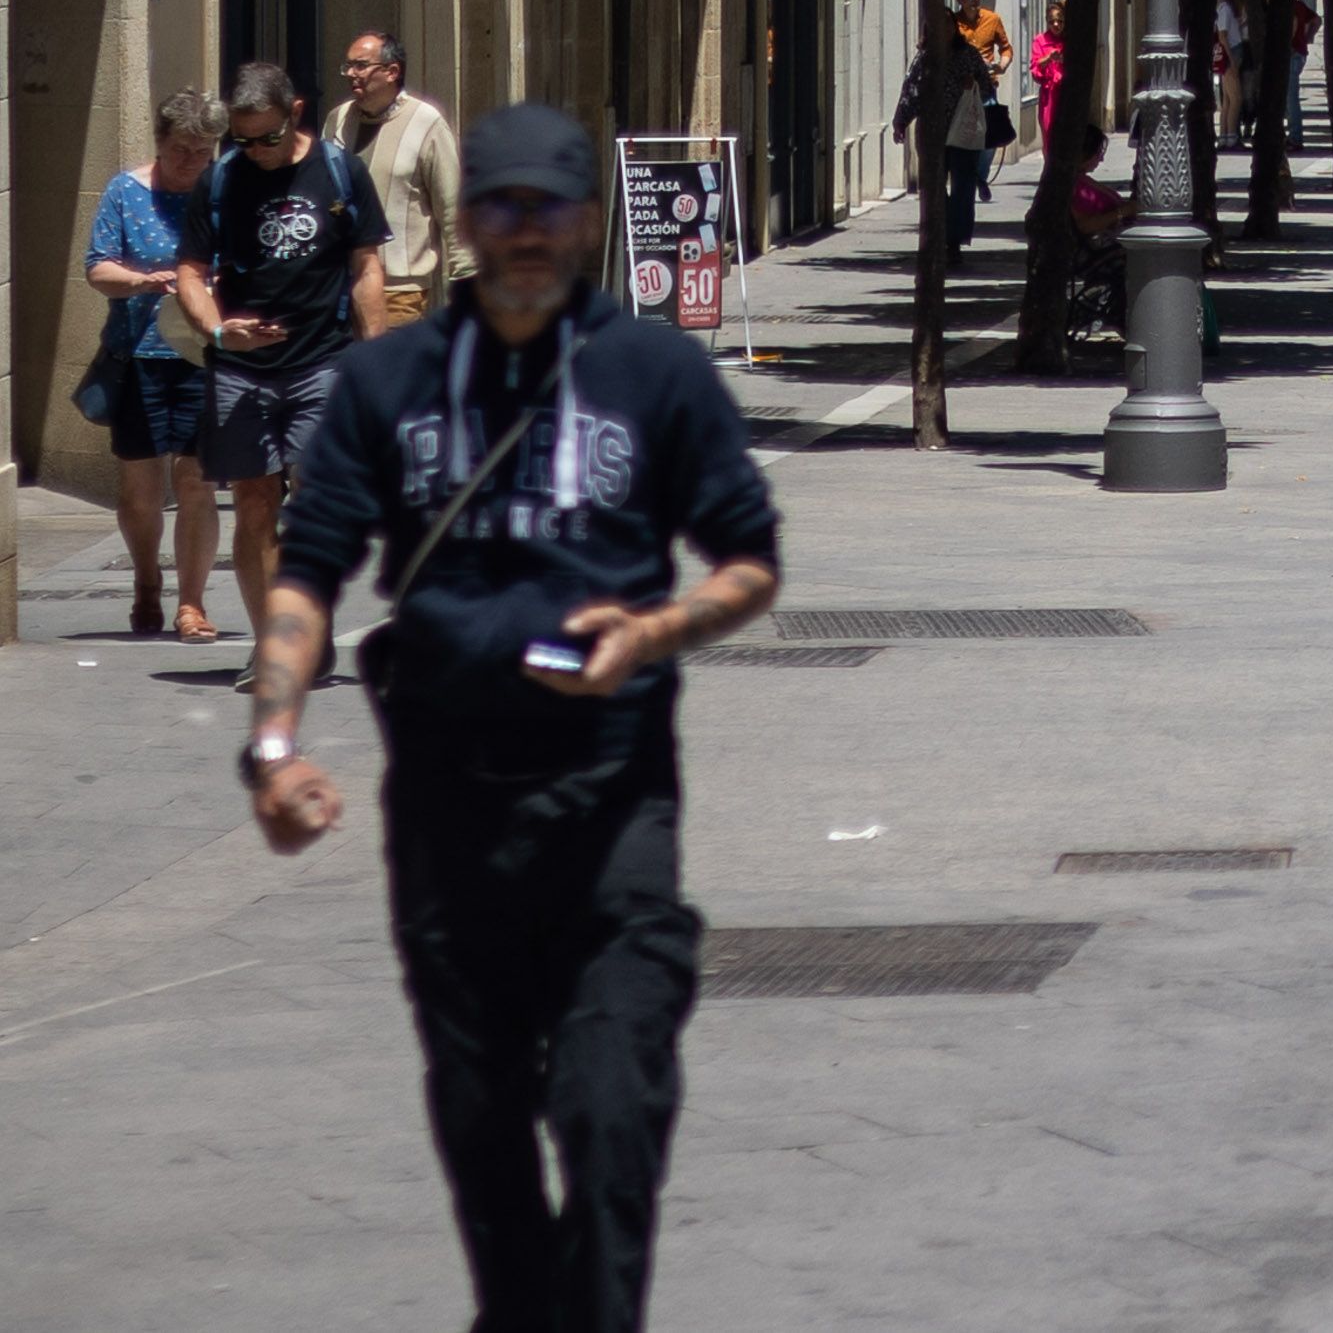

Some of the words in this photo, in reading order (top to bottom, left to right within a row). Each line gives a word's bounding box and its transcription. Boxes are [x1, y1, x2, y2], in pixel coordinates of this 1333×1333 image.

[626, 167, 652, 178] UNA
[627, 181, 681, 192] CARCASA
[628, 196, 658, 206] PARA
[629, 210, 659, 221] CADA
